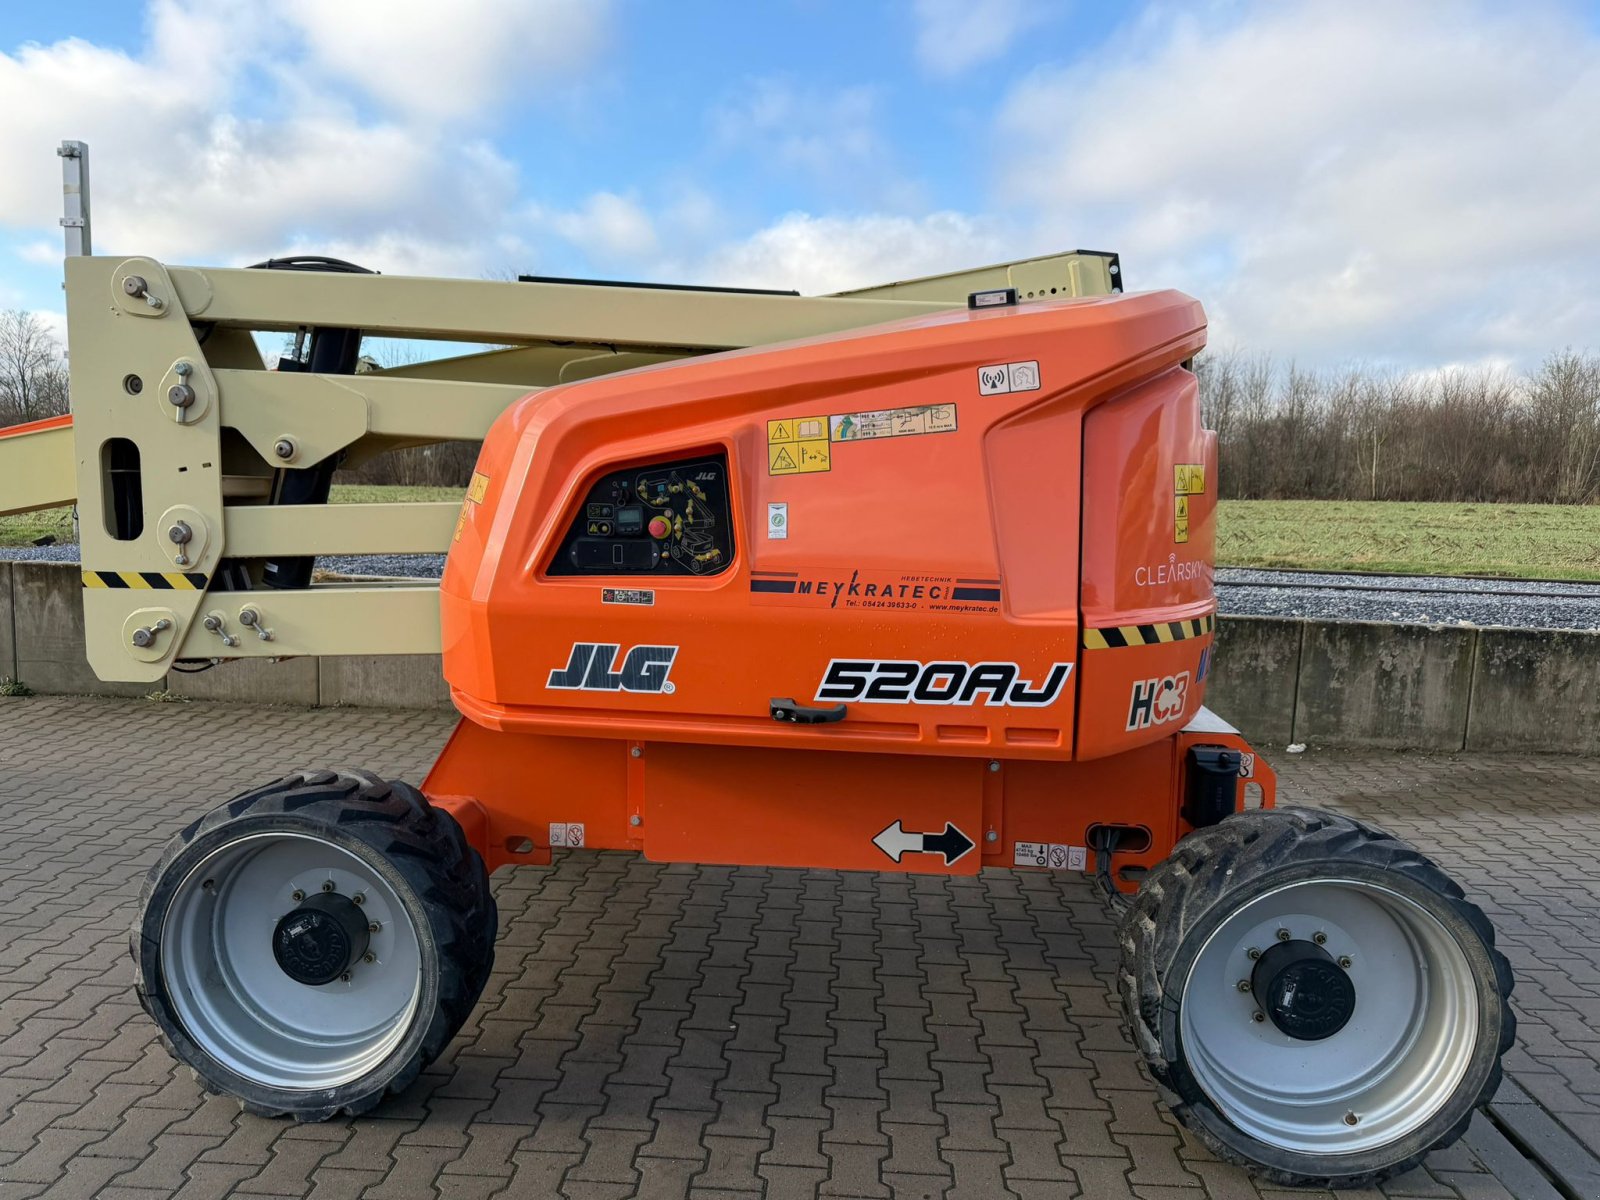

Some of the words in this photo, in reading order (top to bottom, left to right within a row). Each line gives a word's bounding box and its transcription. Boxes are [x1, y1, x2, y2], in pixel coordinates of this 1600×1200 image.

[695, 472, 716, 480] JLG
[901, 575, 952, 583] HEBETECHNIK
[1135, 560, 1203, 586] CLEARSKY
[798, 579, 942, 601] MEYKRATEC
[846, 599, 860, 607] Tel.:
[929, 604, 999, 613] www.meykratec.de
[546, 642, 679, 693] JLG
[814, 658, 1074, 707] 520AJ
[1125, 671, 1190, 732] HC3
